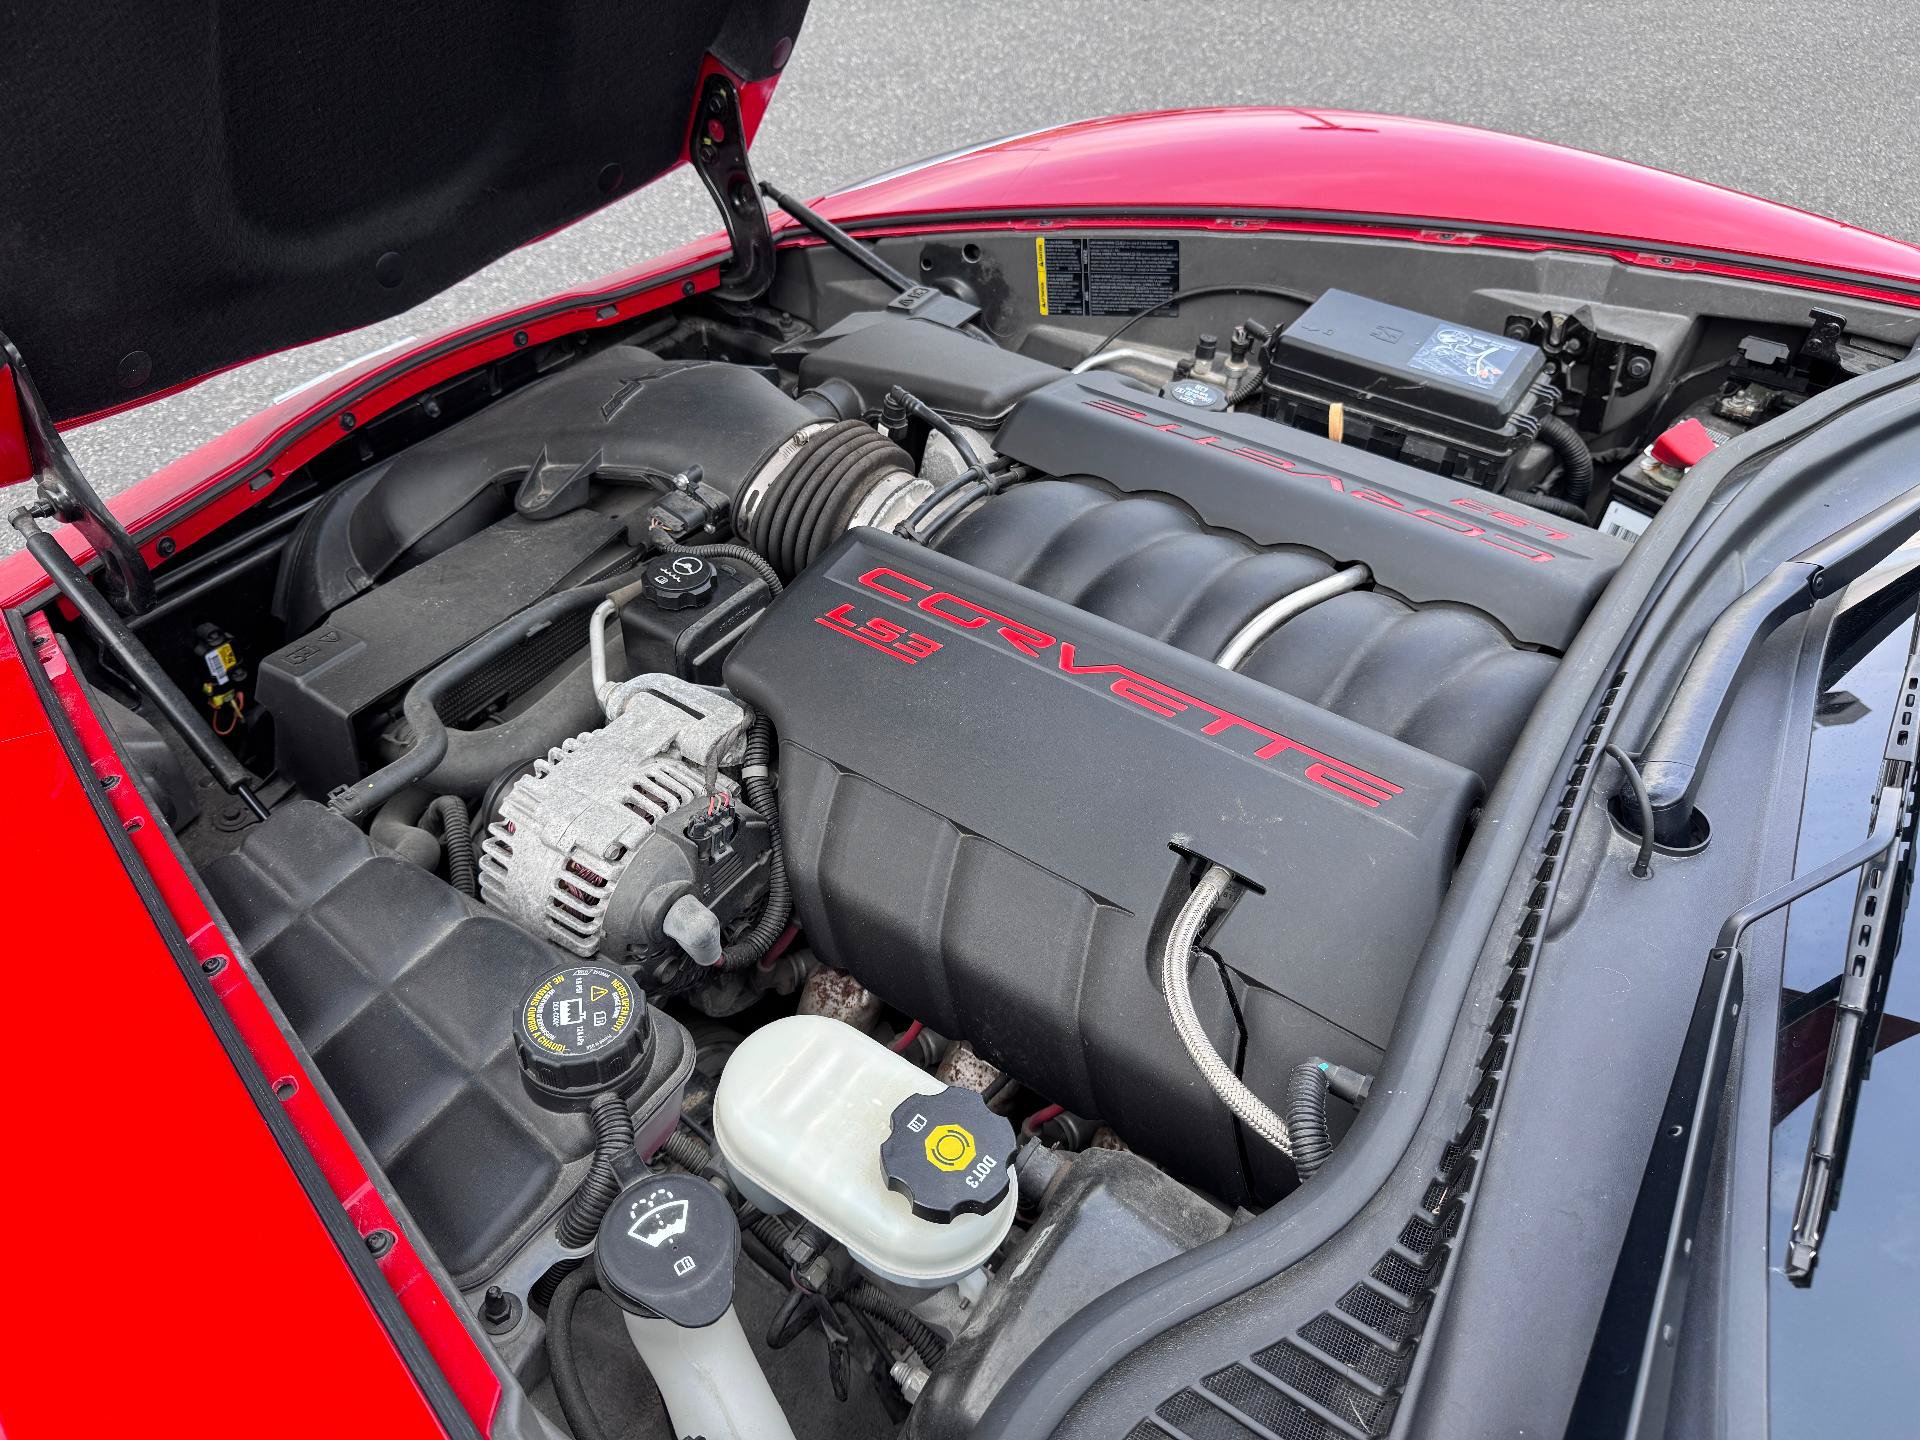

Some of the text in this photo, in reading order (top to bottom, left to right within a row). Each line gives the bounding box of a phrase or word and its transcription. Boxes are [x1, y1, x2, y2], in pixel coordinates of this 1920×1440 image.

[1081, 399, 1556, 563] CORVETTE
[1450, 497, 1573, 541] LS3
[815, 603, 944, 664] LS3
[857, 567, 1404, 808] CORVETTE
[531, 981, 552, 1006] JAMAIS
[552, 975, 565, 985] NE
[611, 979, 627, 998] NEVER
[621, 997, 630, 1015] OPEN
[527, 1007, 538, 1031] OUVRIR
